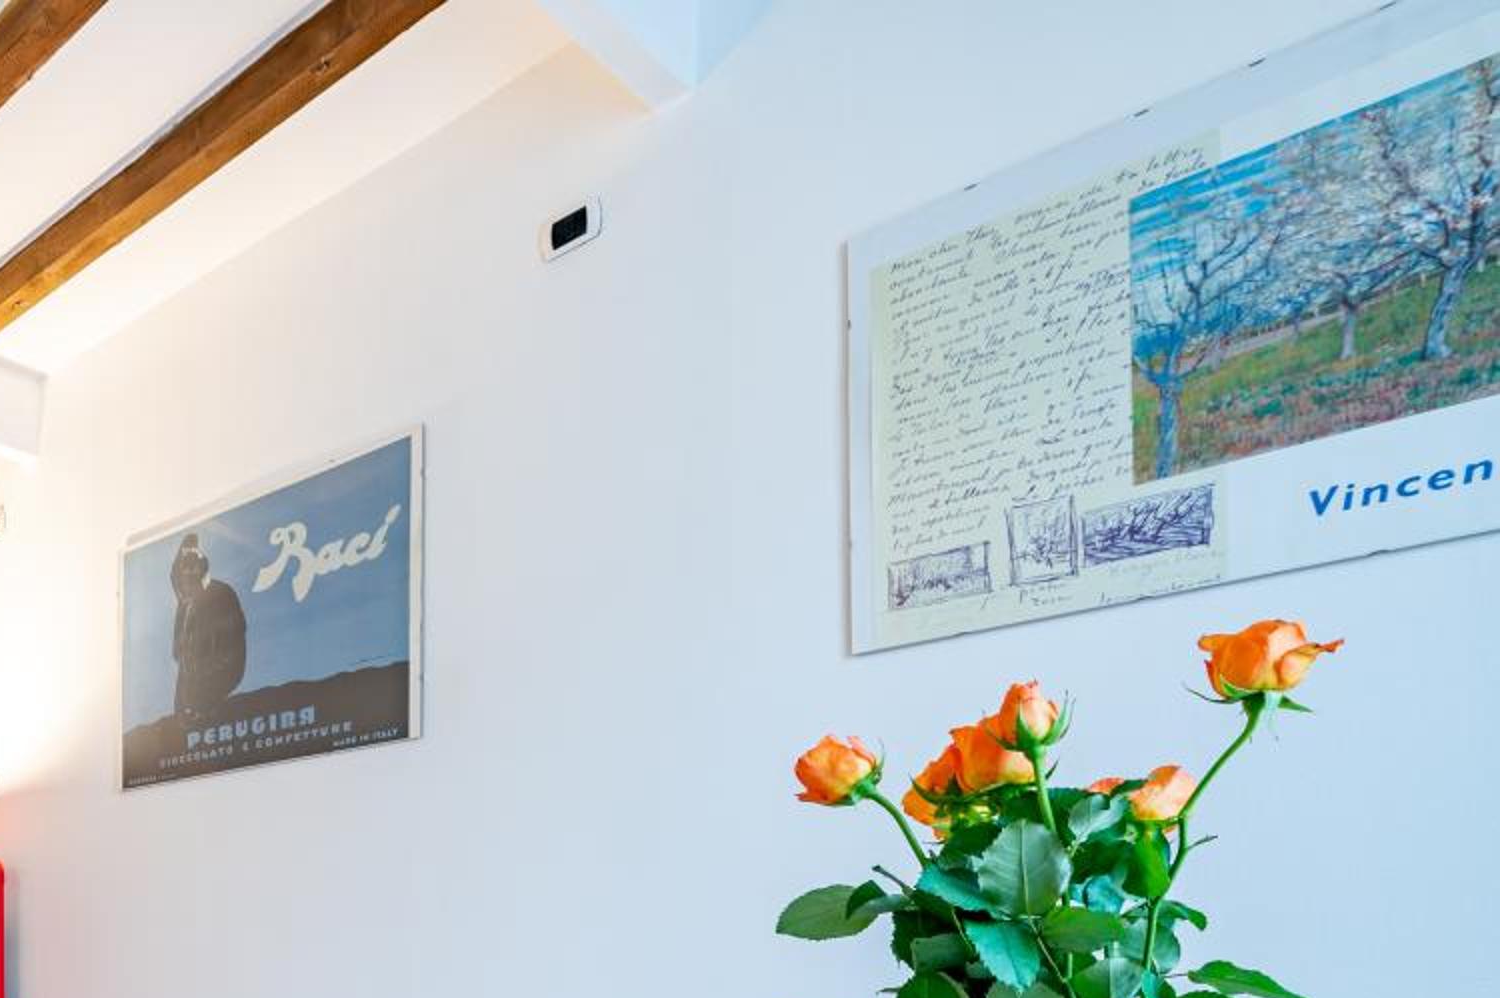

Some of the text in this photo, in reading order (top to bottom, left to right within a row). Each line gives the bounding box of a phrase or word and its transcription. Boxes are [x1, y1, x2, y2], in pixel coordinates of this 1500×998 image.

[1308, 459, 1494, 517] Vincen
[252, 503, 402, 603] Baci
[186, 704, 316, 748] PERUGINA
